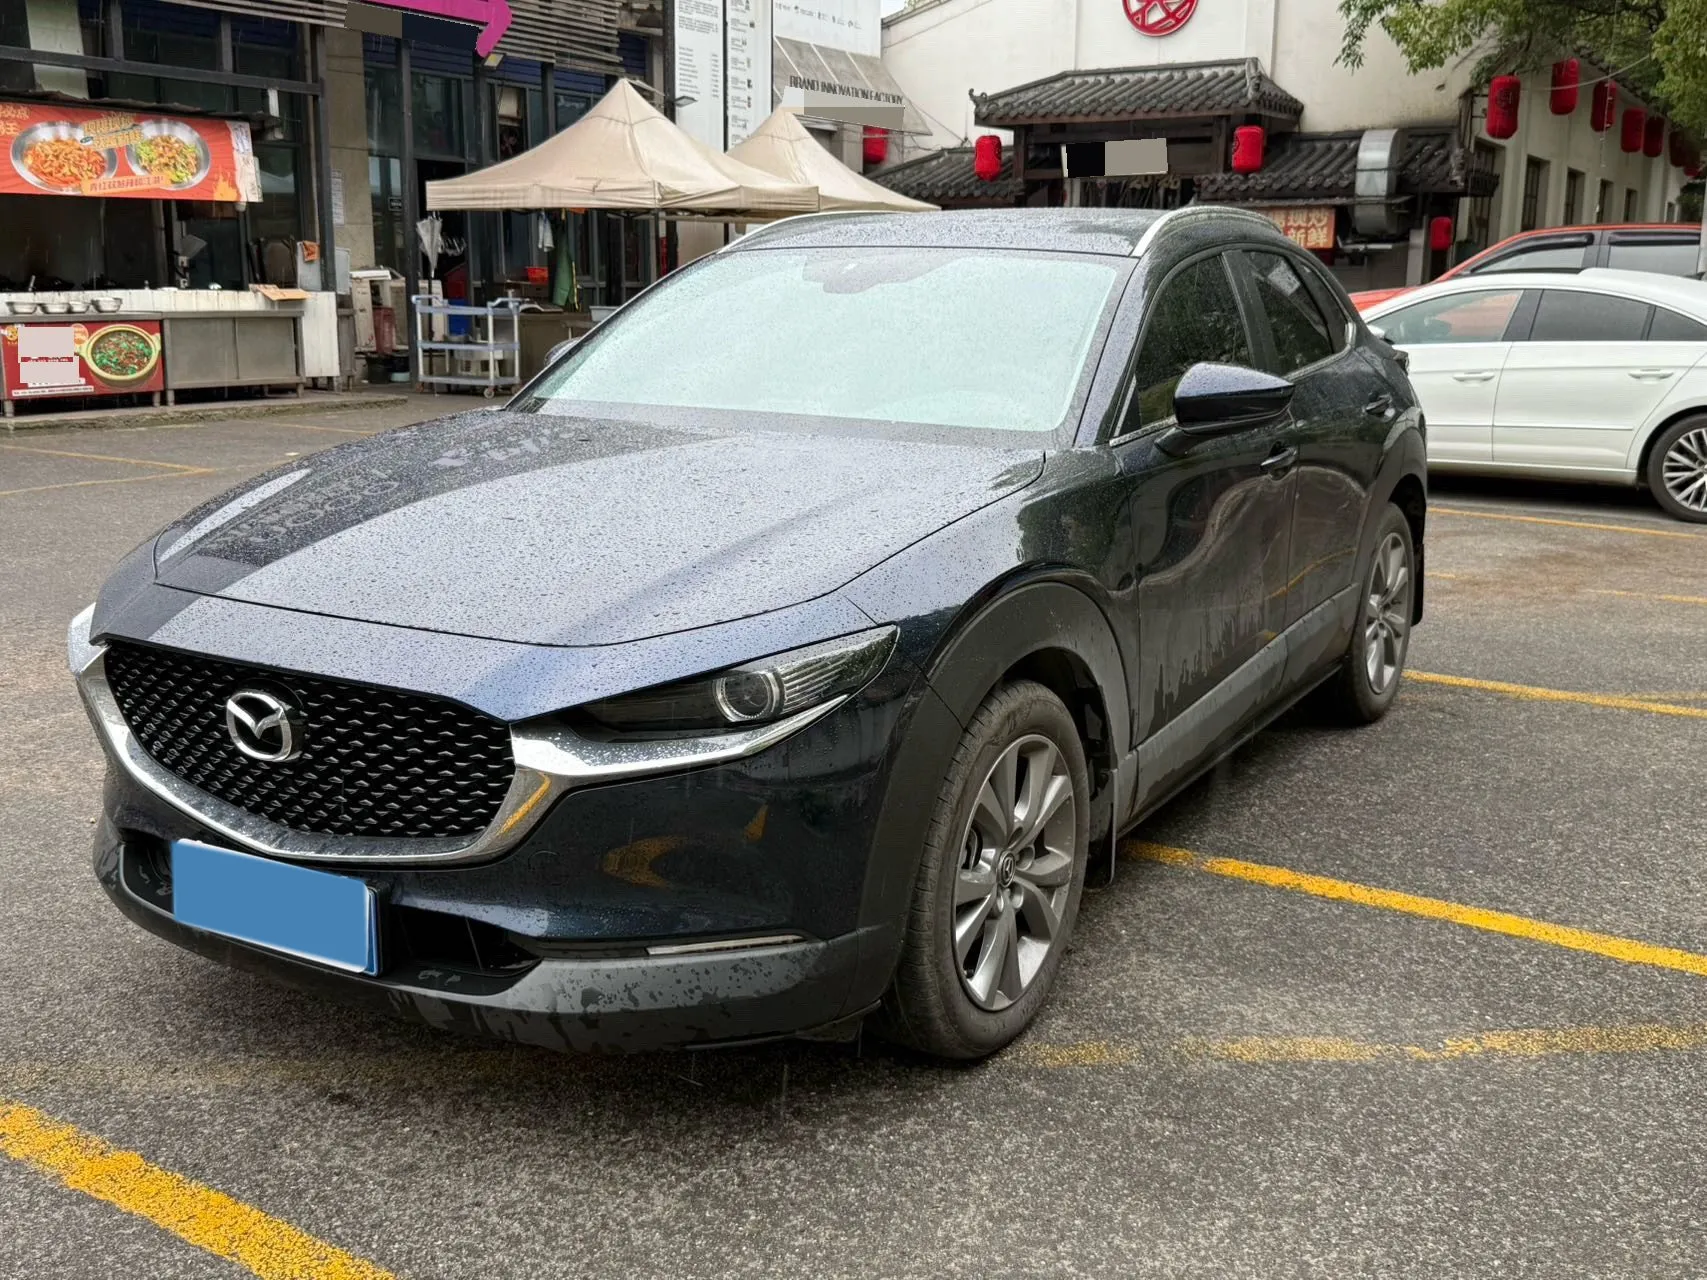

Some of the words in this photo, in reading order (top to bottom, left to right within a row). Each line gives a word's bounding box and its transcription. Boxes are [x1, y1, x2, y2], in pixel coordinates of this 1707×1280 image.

[789, 75, 820, 92] BRAND
[821, 81, 869, 100] INNOVATION
[869, 91, 904, 105] FACTORY
